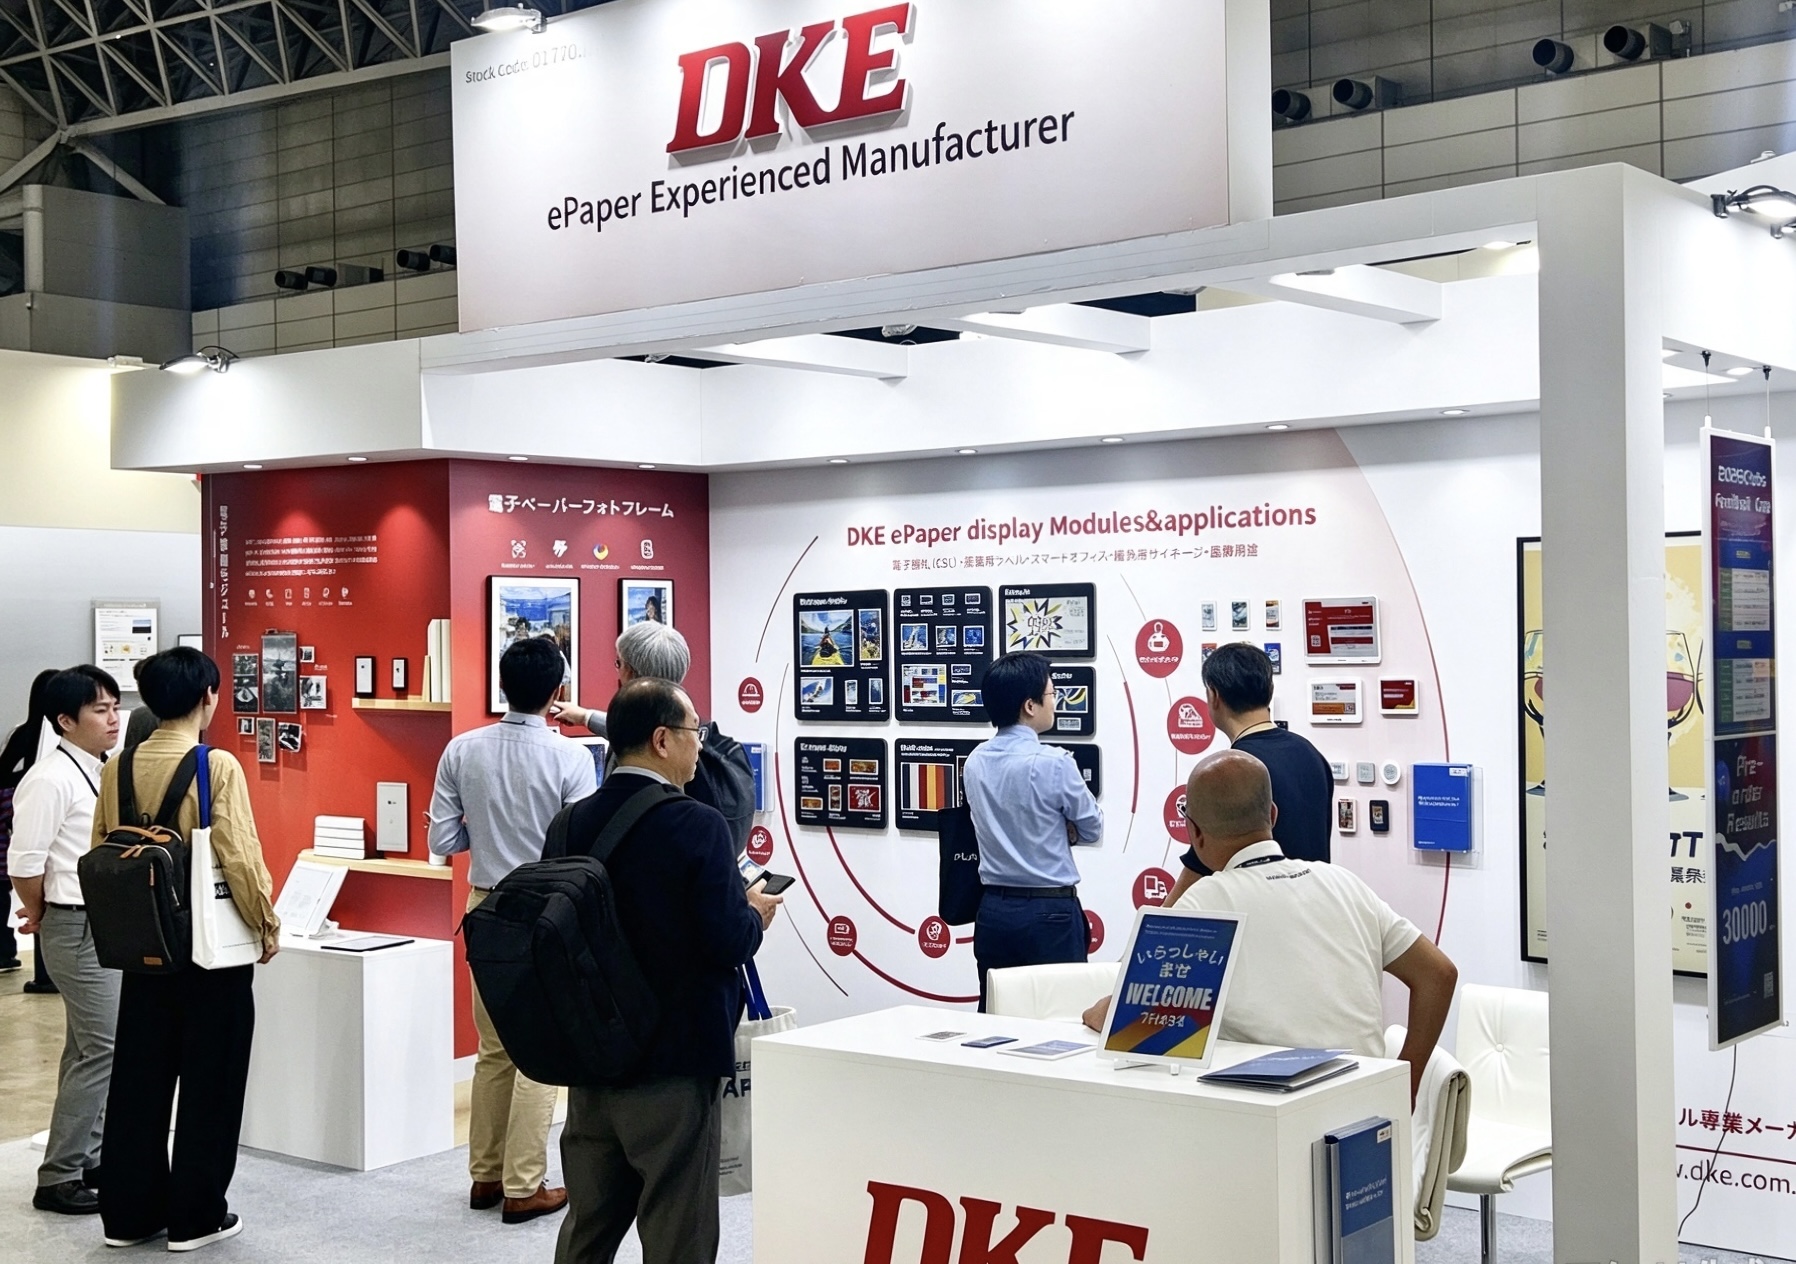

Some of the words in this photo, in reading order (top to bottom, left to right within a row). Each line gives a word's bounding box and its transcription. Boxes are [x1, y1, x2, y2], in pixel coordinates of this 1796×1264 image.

[465, 65, 496, 83] Stock
[666, 3, 911, 155] DKE
[547, 189, 642, 233] ePaper
[650, 152, 832, 218] Experienced
[841, 110, 1075, 181] Manufacturer
[488, 493, 675, 518] 電子ペーパーフォトフレーム
[847, 525, 886, 547] DKE
[890, 522, 962, 548] ePaper
[967, 516, 1044, 546] display
[1050, 502, 1317, 537] Modules&applications
[1722, 899, 1768, 946] 30000
[1136, 943, 1225, 967] いらっしゃい
[1158, 961, 1192, 979] ませ
[1125, 982, 1214, 1011] WELCOME
